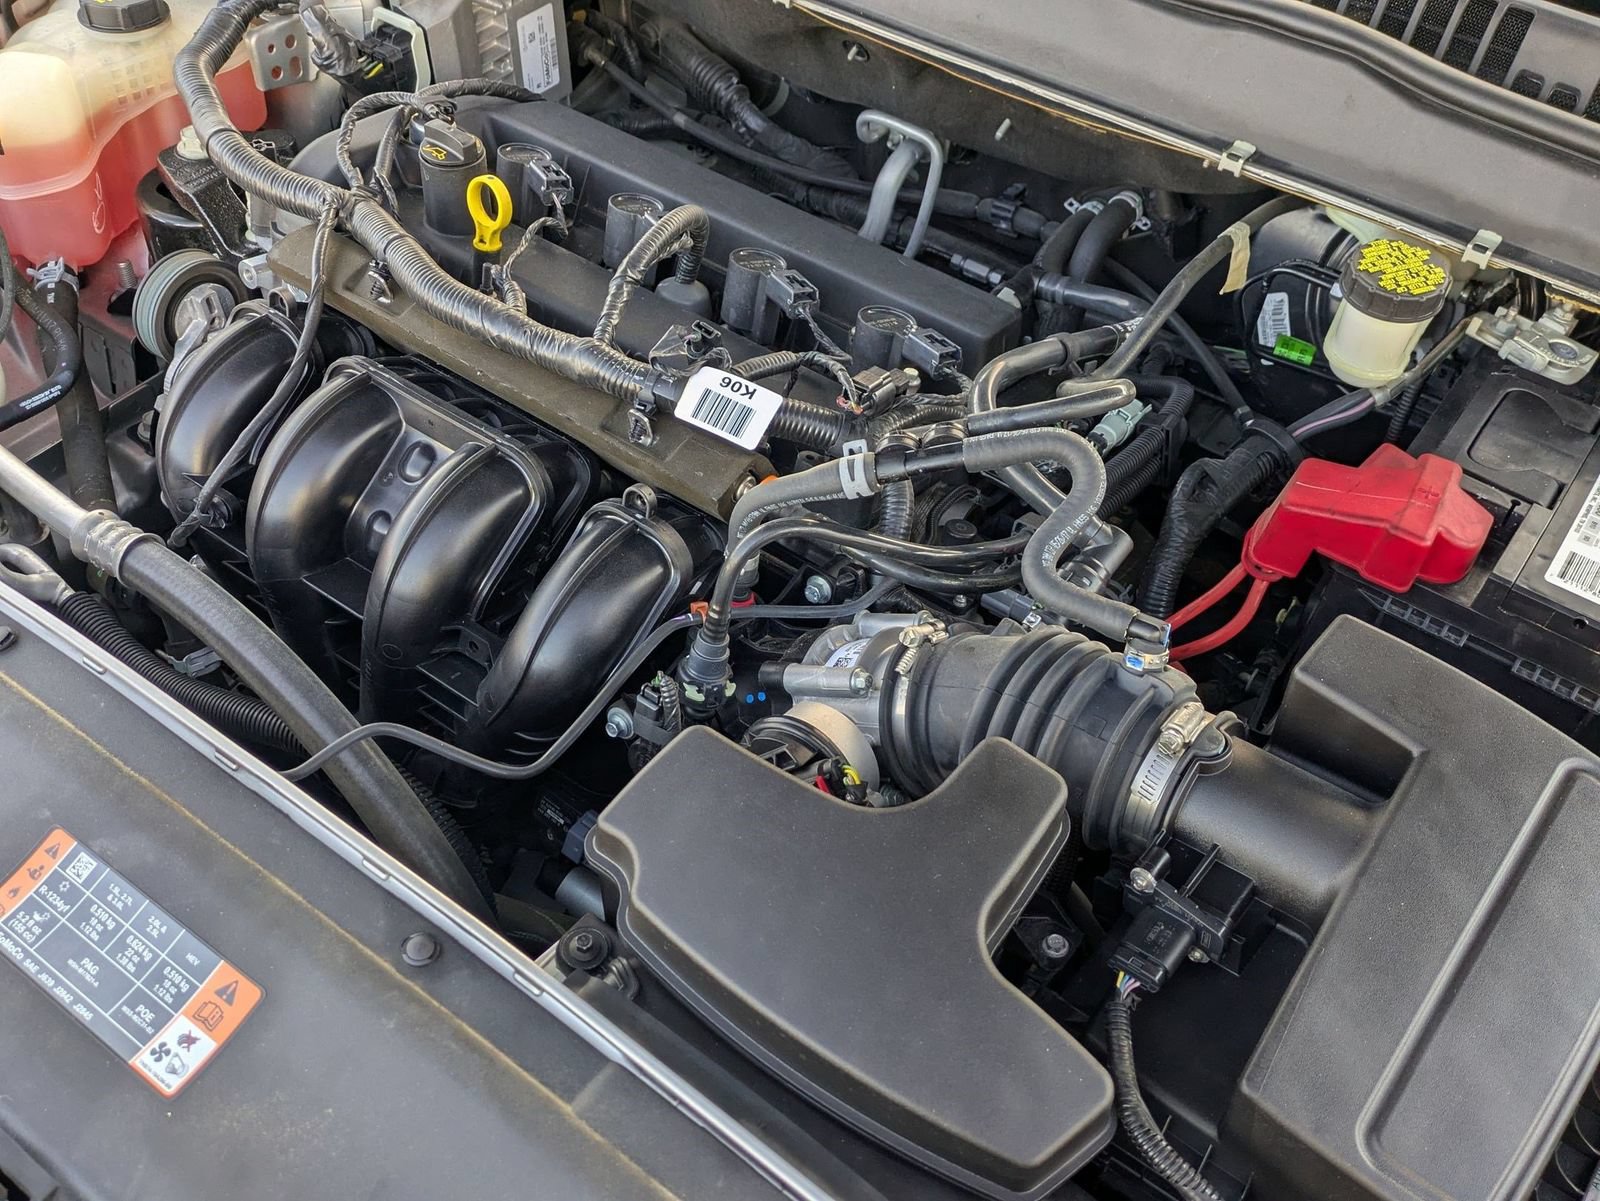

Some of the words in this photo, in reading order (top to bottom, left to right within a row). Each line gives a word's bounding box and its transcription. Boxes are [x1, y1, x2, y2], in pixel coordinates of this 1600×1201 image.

[720, 376, 757, 400] K06
[36, 883, 70, 914] R-1234yf
[15, 910, 29, 923] 5.2
[31, 924, 42, 935] oz
[89, 903, 109, 922] 0.510
[103, 916, 117, 930] kg
[7, 917, 25, 935] (155
[21, 929, 36, 944] cc)
[79, 921, 92, 934] 1.12
[89, 930, 100, 941] lbs
[80, 956, 99, 975] PAG
[140, 948, 154, 962] kg
[184, 952, 200, 966] HEV
[126, 961, 137, 972] lbs
[22, 957, 39, 973] SAE
[36, 969, 55, 987] J639
[51, 983, 74, 1004] J2842
[71, 1000, 94, 1021] J2845
[162, 965, 183, 984] 0.510
[177, 978, 191, 993] kg
[152, 983, 166, 996] 1.12
[163, 992, 174, 1003] lbs
[134, 1003, 155, 1023] POE
